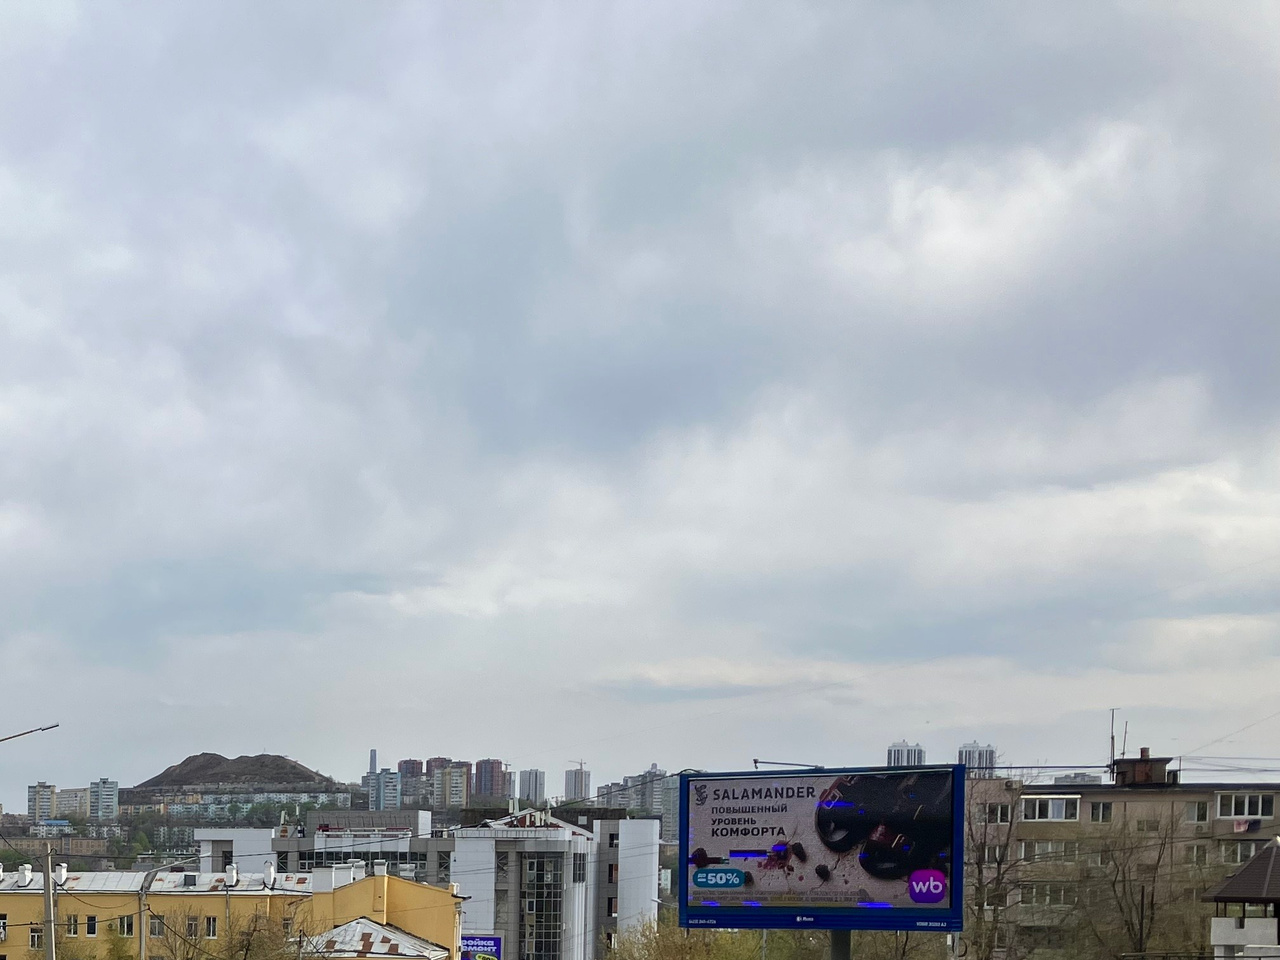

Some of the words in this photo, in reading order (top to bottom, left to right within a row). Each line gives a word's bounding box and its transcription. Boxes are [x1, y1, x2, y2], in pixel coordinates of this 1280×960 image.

[713, 786, 816, 801] SALAMANDER
[711, 803, 788, 814] ПОВЫШЕННЫЙ
[711, 817, 757, 826] УРОВЕНЬ
[711, 826, 786, 837] КОМФОРТА
[912, 878, 943, 894] wb
